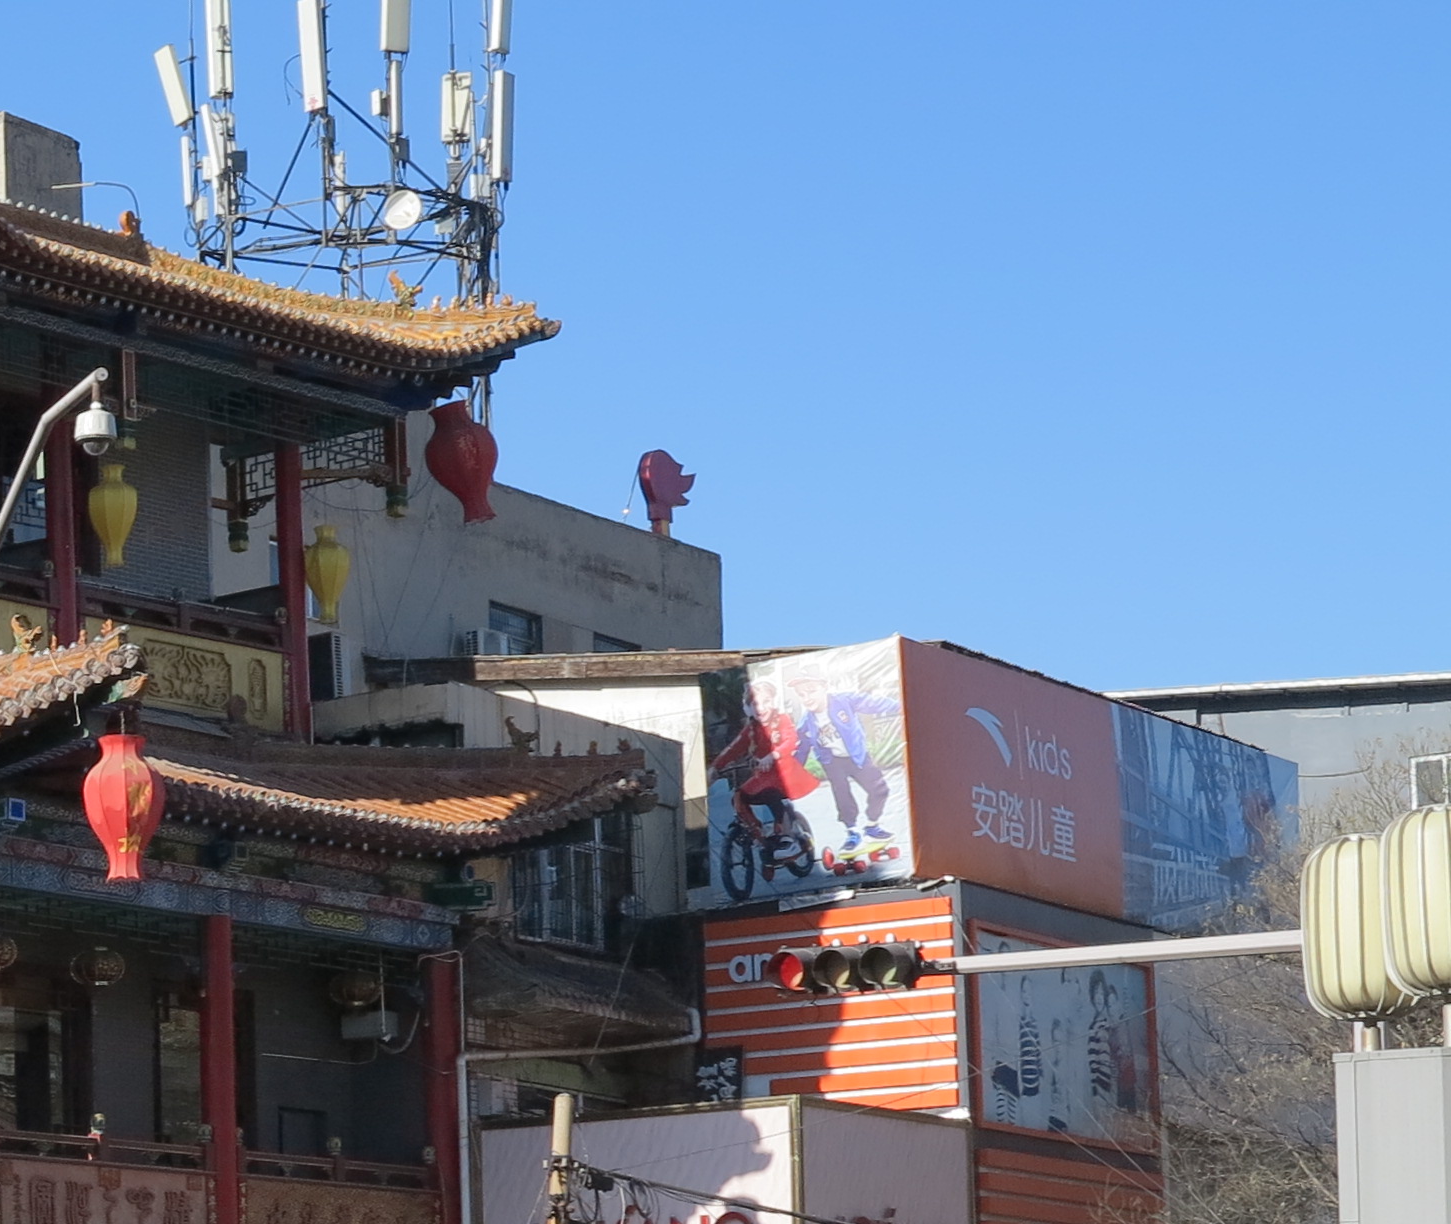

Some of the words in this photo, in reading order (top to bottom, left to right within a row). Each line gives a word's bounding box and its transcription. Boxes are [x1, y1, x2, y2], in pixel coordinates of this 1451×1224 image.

[1025, 715, 1073, 781] kids
[971, 781, 1078, 862] 安踏儿童
